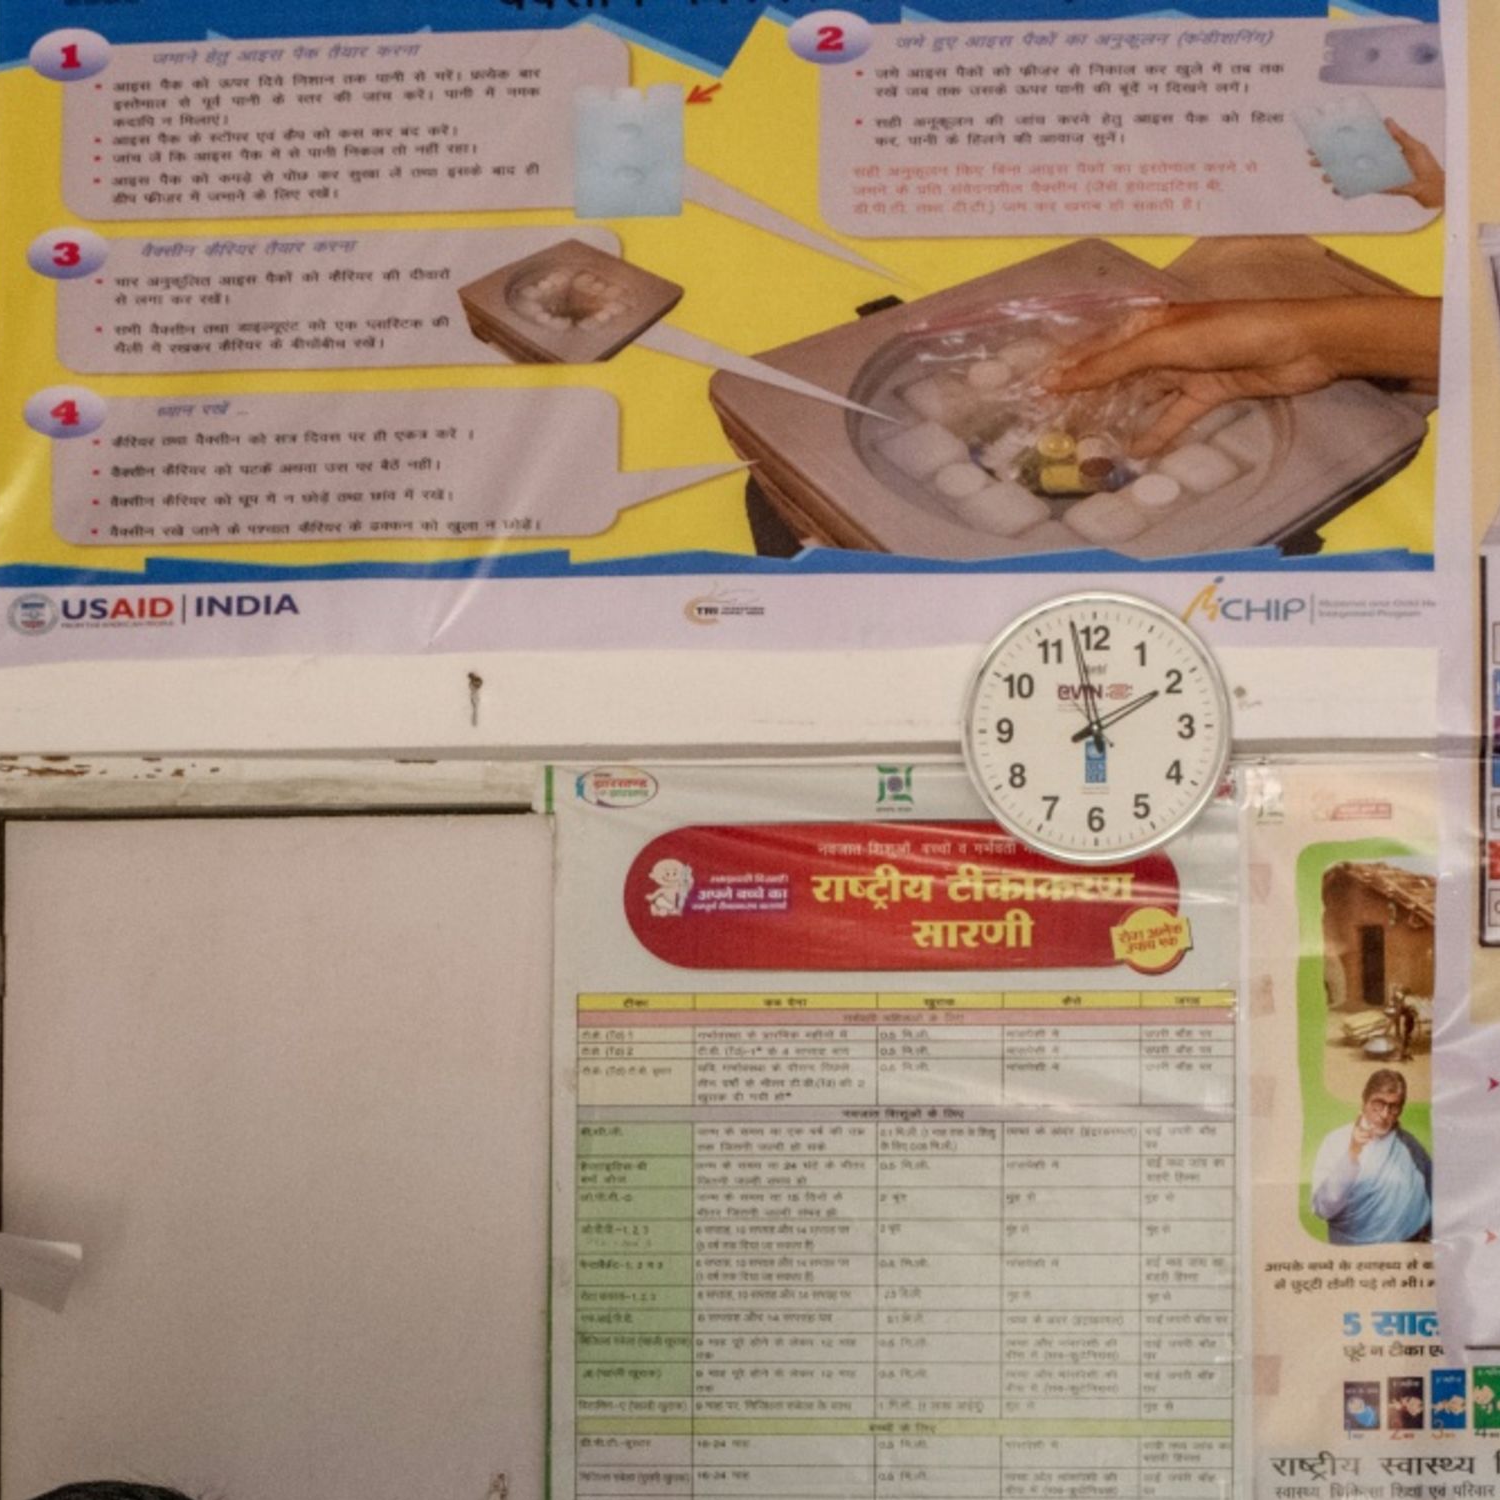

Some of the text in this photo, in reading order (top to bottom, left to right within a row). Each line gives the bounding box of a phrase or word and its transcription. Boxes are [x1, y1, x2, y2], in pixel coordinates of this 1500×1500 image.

[816, 26, 845, 51] 2
[60, 44, 81, 69] 1
[52, 242, 81, 266] 3
[50, 400, 80, 425] 4
[61, 593, 300, 619] USAID INDIA
[1079, 626, 1110, 652] 12
[1039, 640, 1063, 664] 11
[1134, 641, 1146, 667] 1
[1003, 673, 1035, 699] 10
[1166, 669, 1182, 695] 2
[997, 718, 1014, 743] 9
[1177, 714, 1195, 738] 3
[1008, 763, 1026, 788] 8
[1166, 760, 1183, 785] 4
[1042, 796, 1060, 820] 7
[1133, 793, 1150, 819] 5
[1087, 807, 1104, 832] 6
[811, 862, 1135, 909] राष्ट्रीय टीकाकरण
[913, 909, 1033, 949] सारणी
[1271, 1450, 1362, 1480] राष्ट्रीय
[1380, 1456, 1476, 1476] स्वास्थ्य
